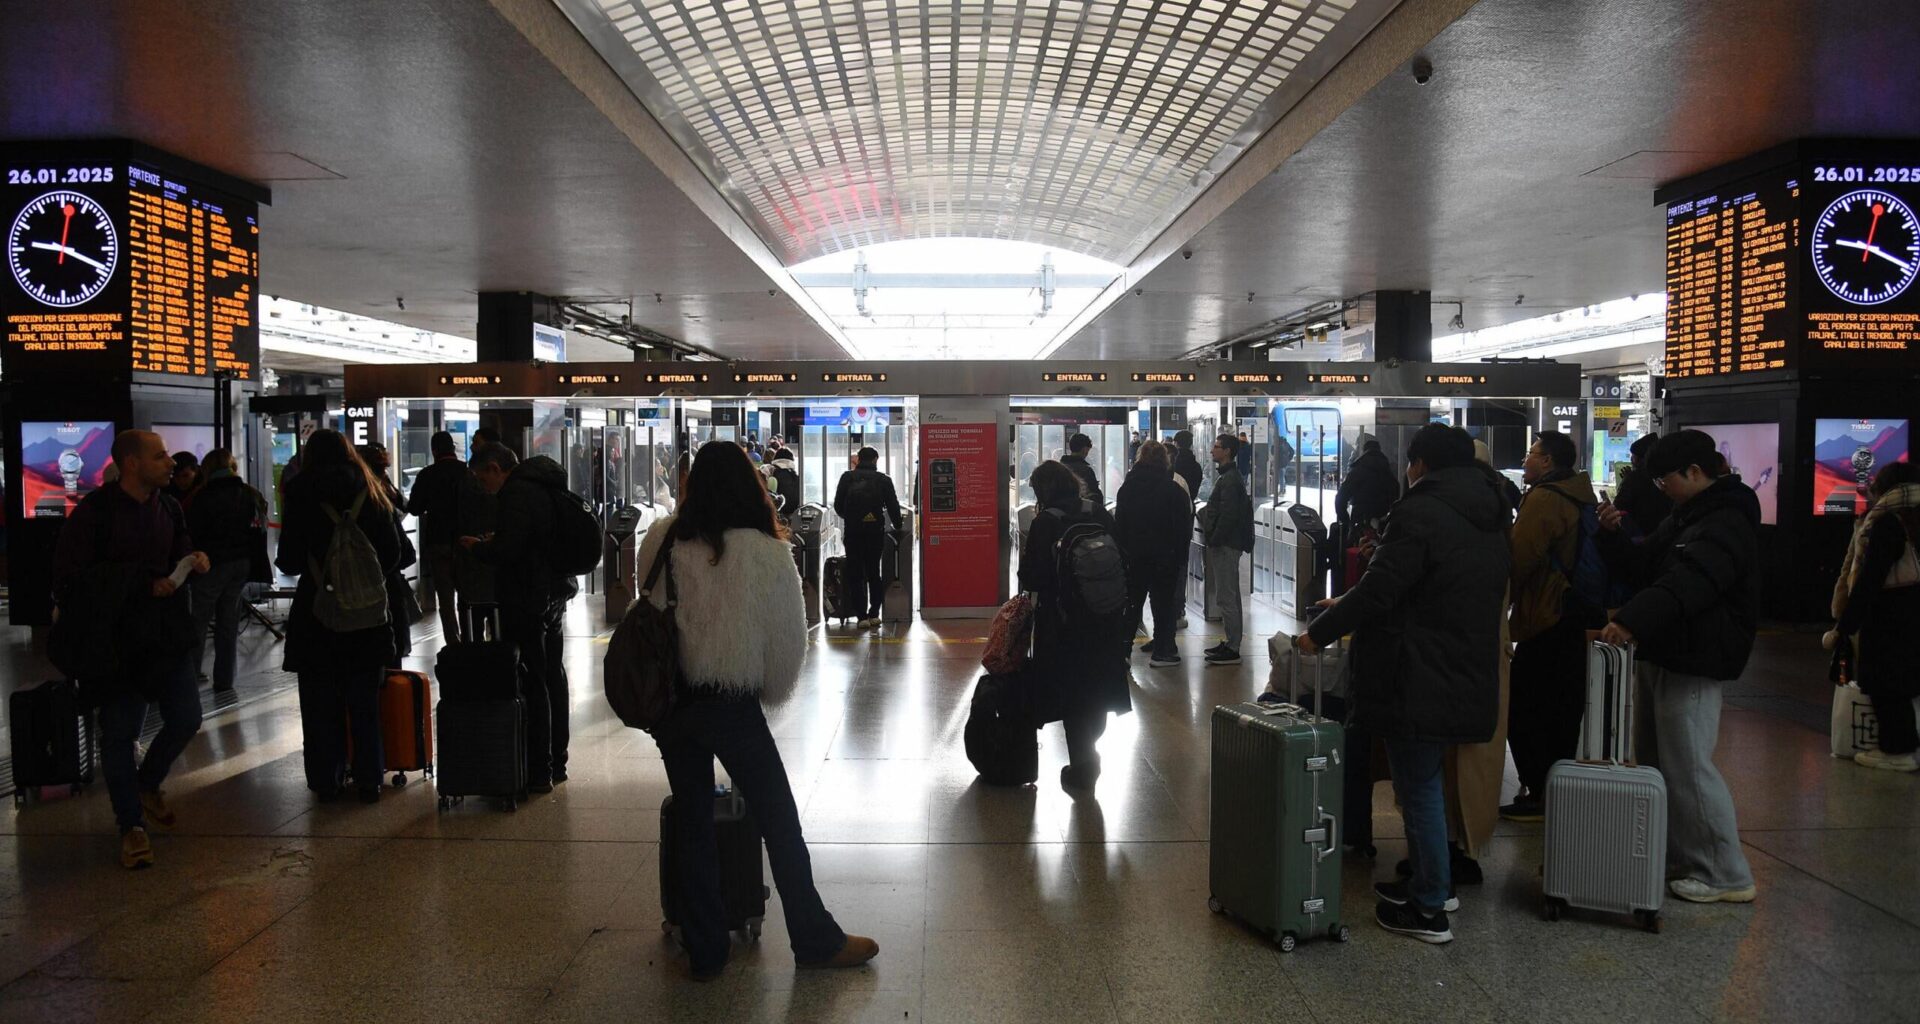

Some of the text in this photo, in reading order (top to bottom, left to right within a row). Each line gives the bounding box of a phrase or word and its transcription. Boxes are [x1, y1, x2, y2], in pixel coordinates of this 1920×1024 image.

[128, 166, 160, 187] PARTENZE
[1668, 201, 1694, 218] PARTENZE
[88, 314, 122, 322] NAZIONALE
[18, 324, 30, 332] DEL
[30, 324, 65, 332] PERSONALE
[66, 323, 78, 331] DEL
[1818, 322, 1914, 331] DEL PERSONALE DEL GRUPPO FS
[40, 333, 60, 341] ITALO
[1840, 332, 1859, 340] ITALO
[1860, 332, 1864, 340] E
[1896, 332, 1912, 340] INFO
[24, 342, 47, 350] CANALI
[60, 342, 66, 350] E
[66, 342, 75, 350] IN
[1824, 341, 1846, 349] CANALI
[1847, 341, 1860, 349] WEB
[1860, 341, 1866, 349] E
[1867, 341, 1875, 349] IN
[453, 376, 488, 384] ENTRATA
[572, 376, 607, 384] ENTRATA
[659, 374, 696, 382] ENTRATA
[348, 407, 374, 418] GATE
[1552, 406, 1578, 416] GATE
[354, 421, 368, 445] E
